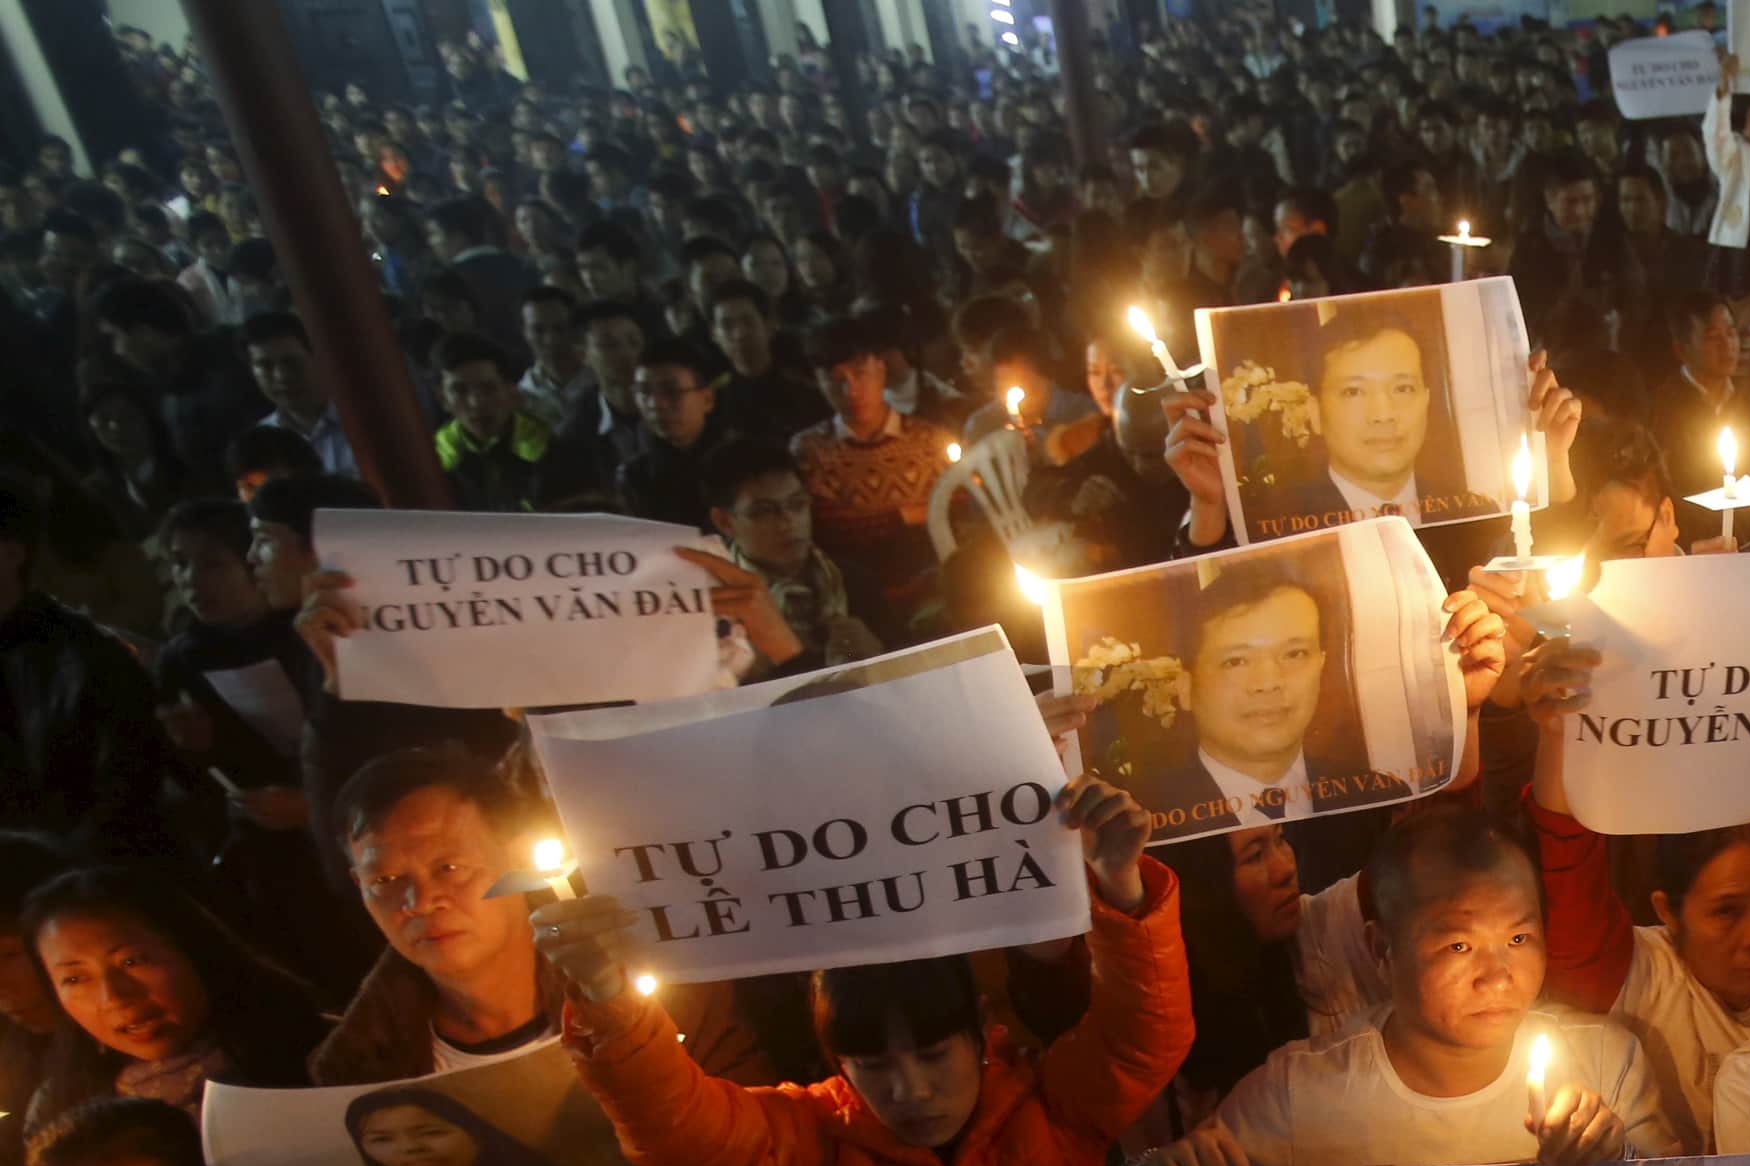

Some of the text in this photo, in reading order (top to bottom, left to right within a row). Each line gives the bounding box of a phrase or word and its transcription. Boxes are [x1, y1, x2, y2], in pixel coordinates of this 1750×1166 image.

[1291, 513, 1319, 531] DO
[1322, 507, 1365, 528] CHO
[397, 551, 637, 591] TỰ DO CHO
[534, 586, 624, 622] VĂN
[634, 582, 710, 617] ĐÀI
[1651, 661, 1715, 706] TỰ
[614, 781, 1052, 886] TỰ DO CHO
[1152, 807, 1186, 830] DO
[1192, 797, 1243, 822] CHO
[648, 839, 1056, 943] LÊ THU HÀ
